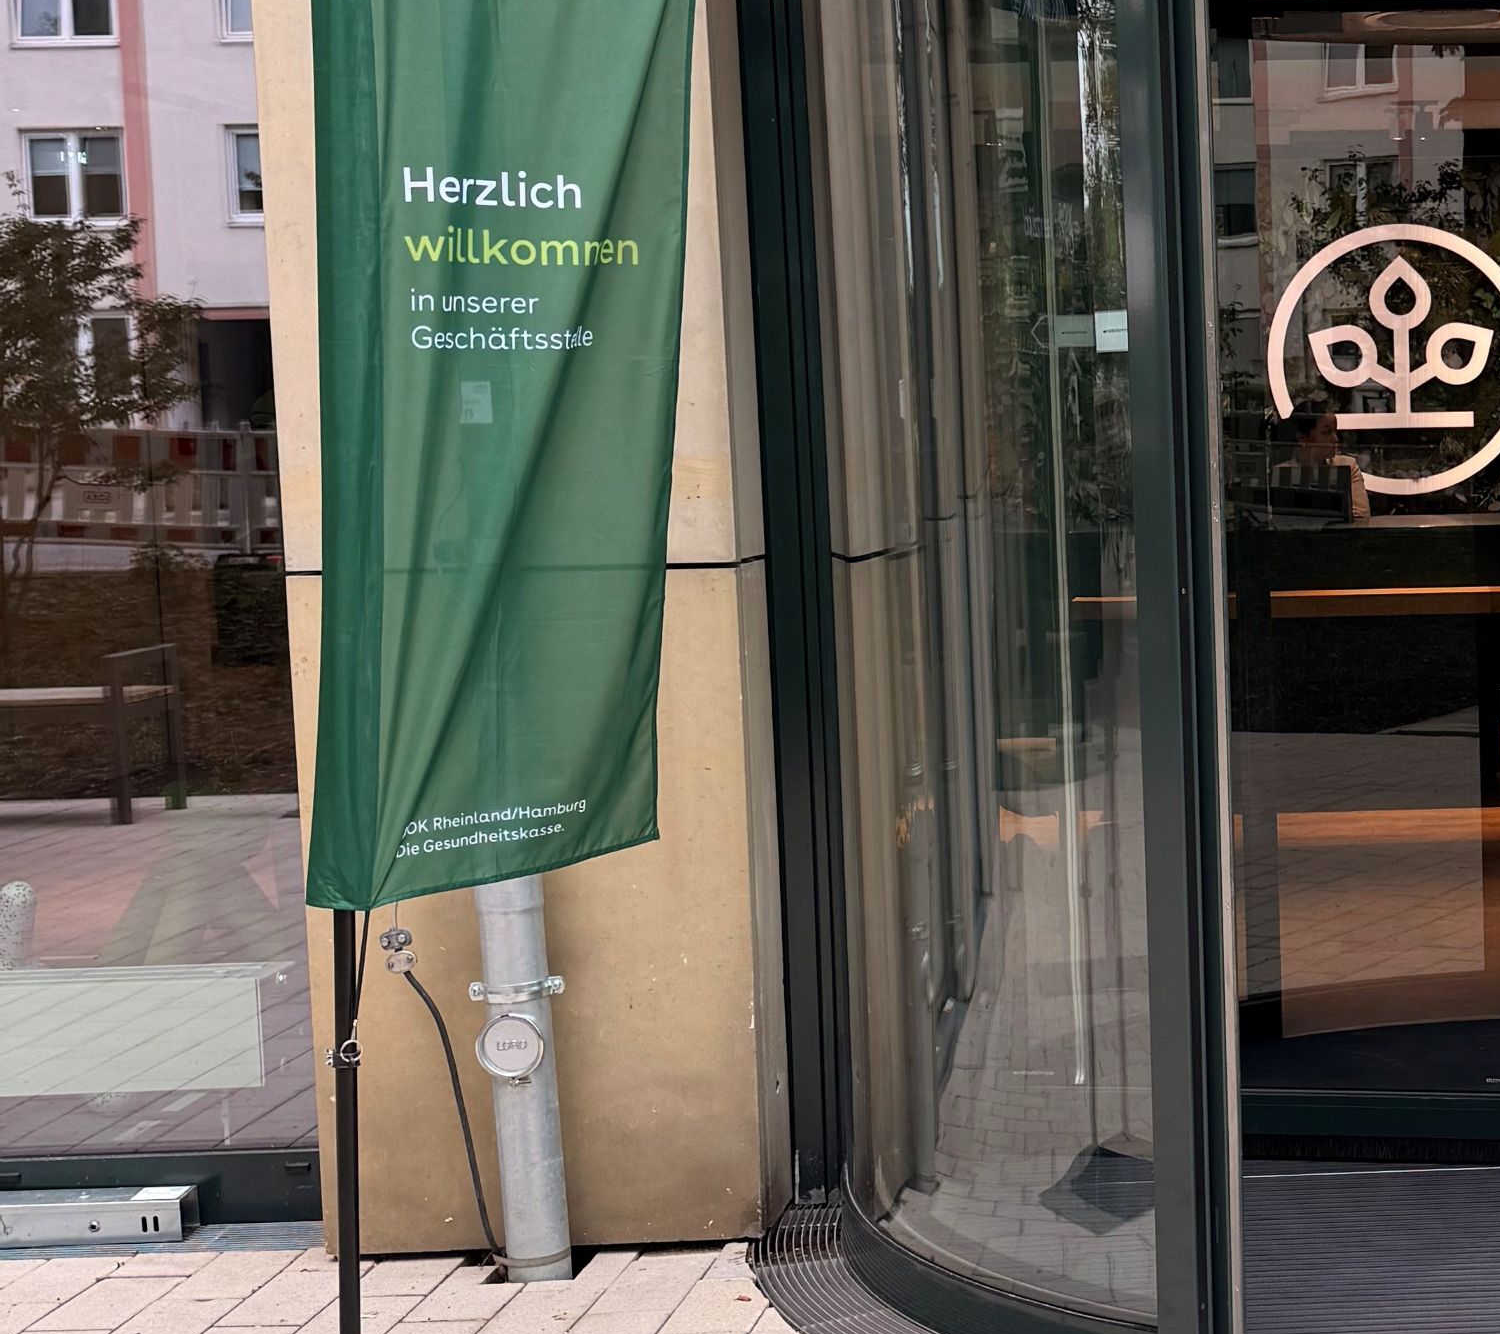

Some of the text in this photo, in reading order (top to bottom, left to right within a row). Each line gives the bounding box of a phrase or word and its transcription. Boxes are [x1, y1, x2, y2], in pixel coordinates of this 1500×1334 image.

[402, 165, 583, 209] Herzlich
[410, 287, 540, 315] in unserer
[433, 797, 587, 831] Rheinland/Hamburg
[396, 821, 565, 859] Die Gesundheitskasse.
